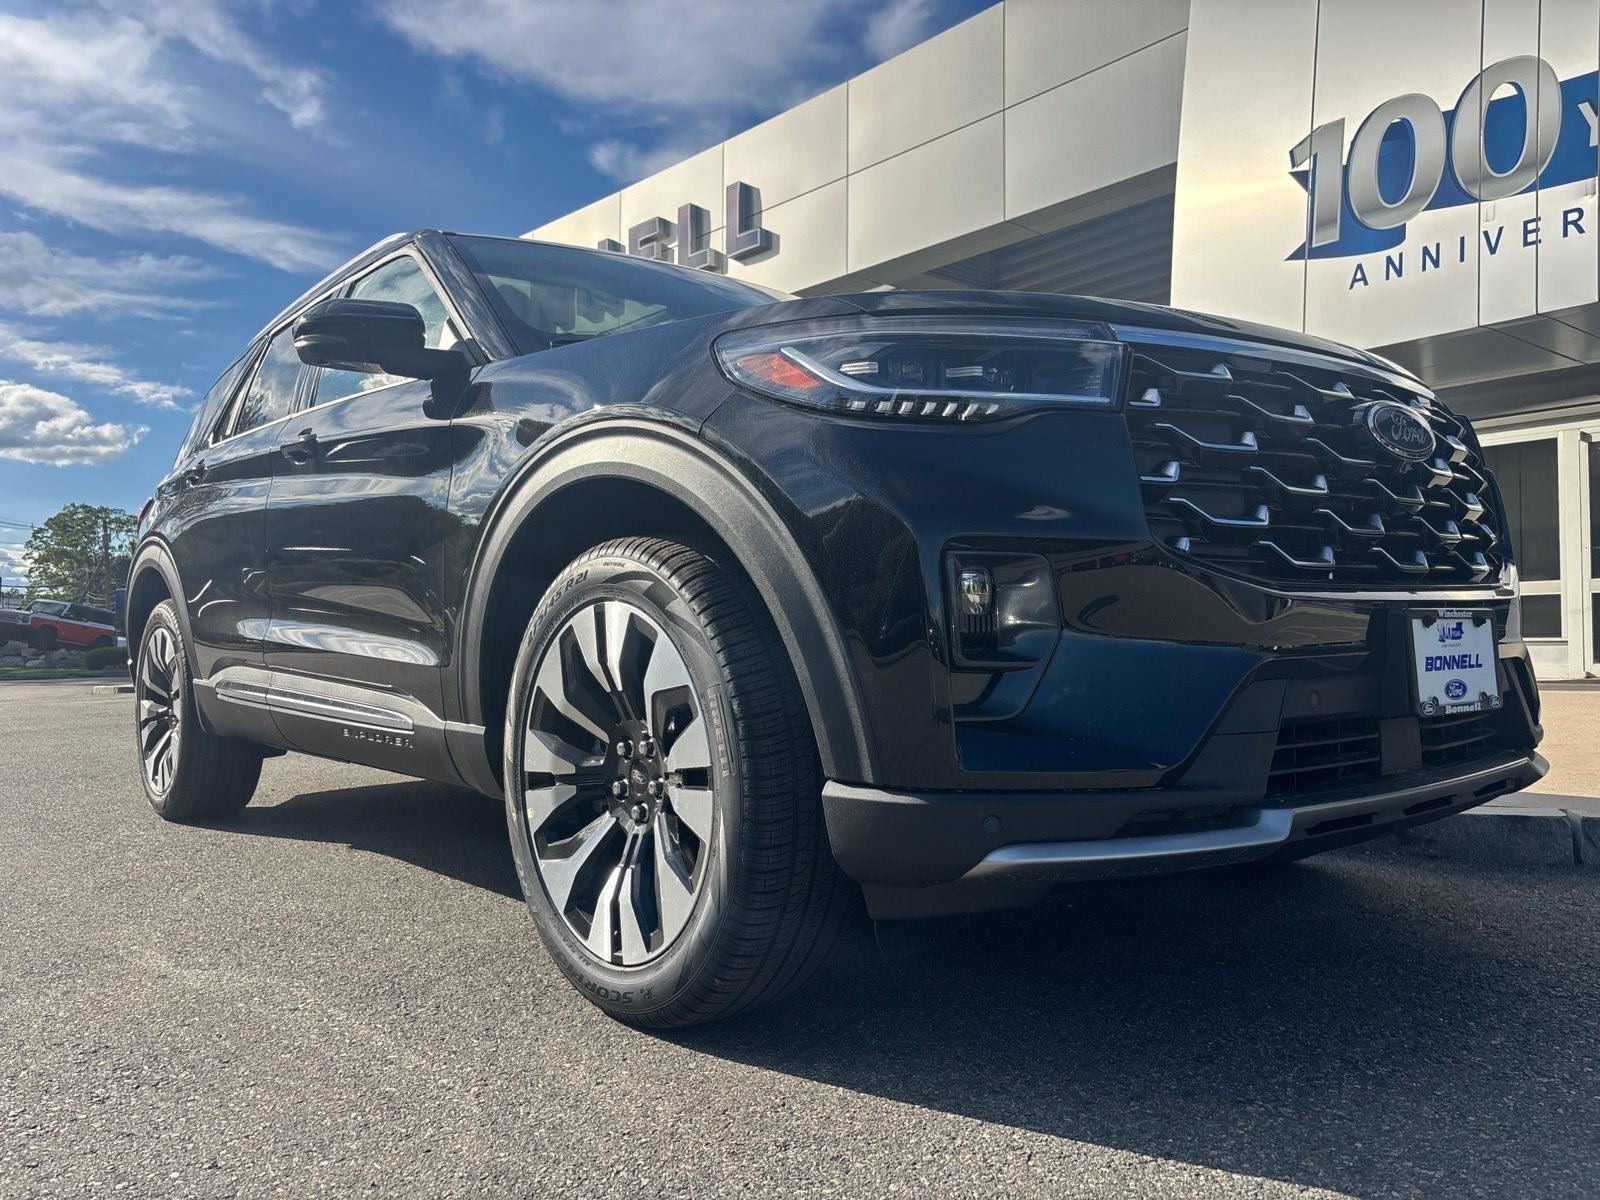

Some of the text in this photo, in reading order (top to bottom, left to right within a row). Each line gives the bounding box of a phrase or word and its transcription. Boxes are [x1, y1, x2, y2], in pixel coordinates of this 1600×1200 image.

[1289, 55, 1562, 248] 100
[1348, 206, 1587, 290] ANNIVER
[1390, 411, 1427, 444] Ford
[1438, 609, 1473, 618] Winchester
[1424, 653, 1483, 672] BONNELL
[1445, 702, 1481, 714] Bonnell
